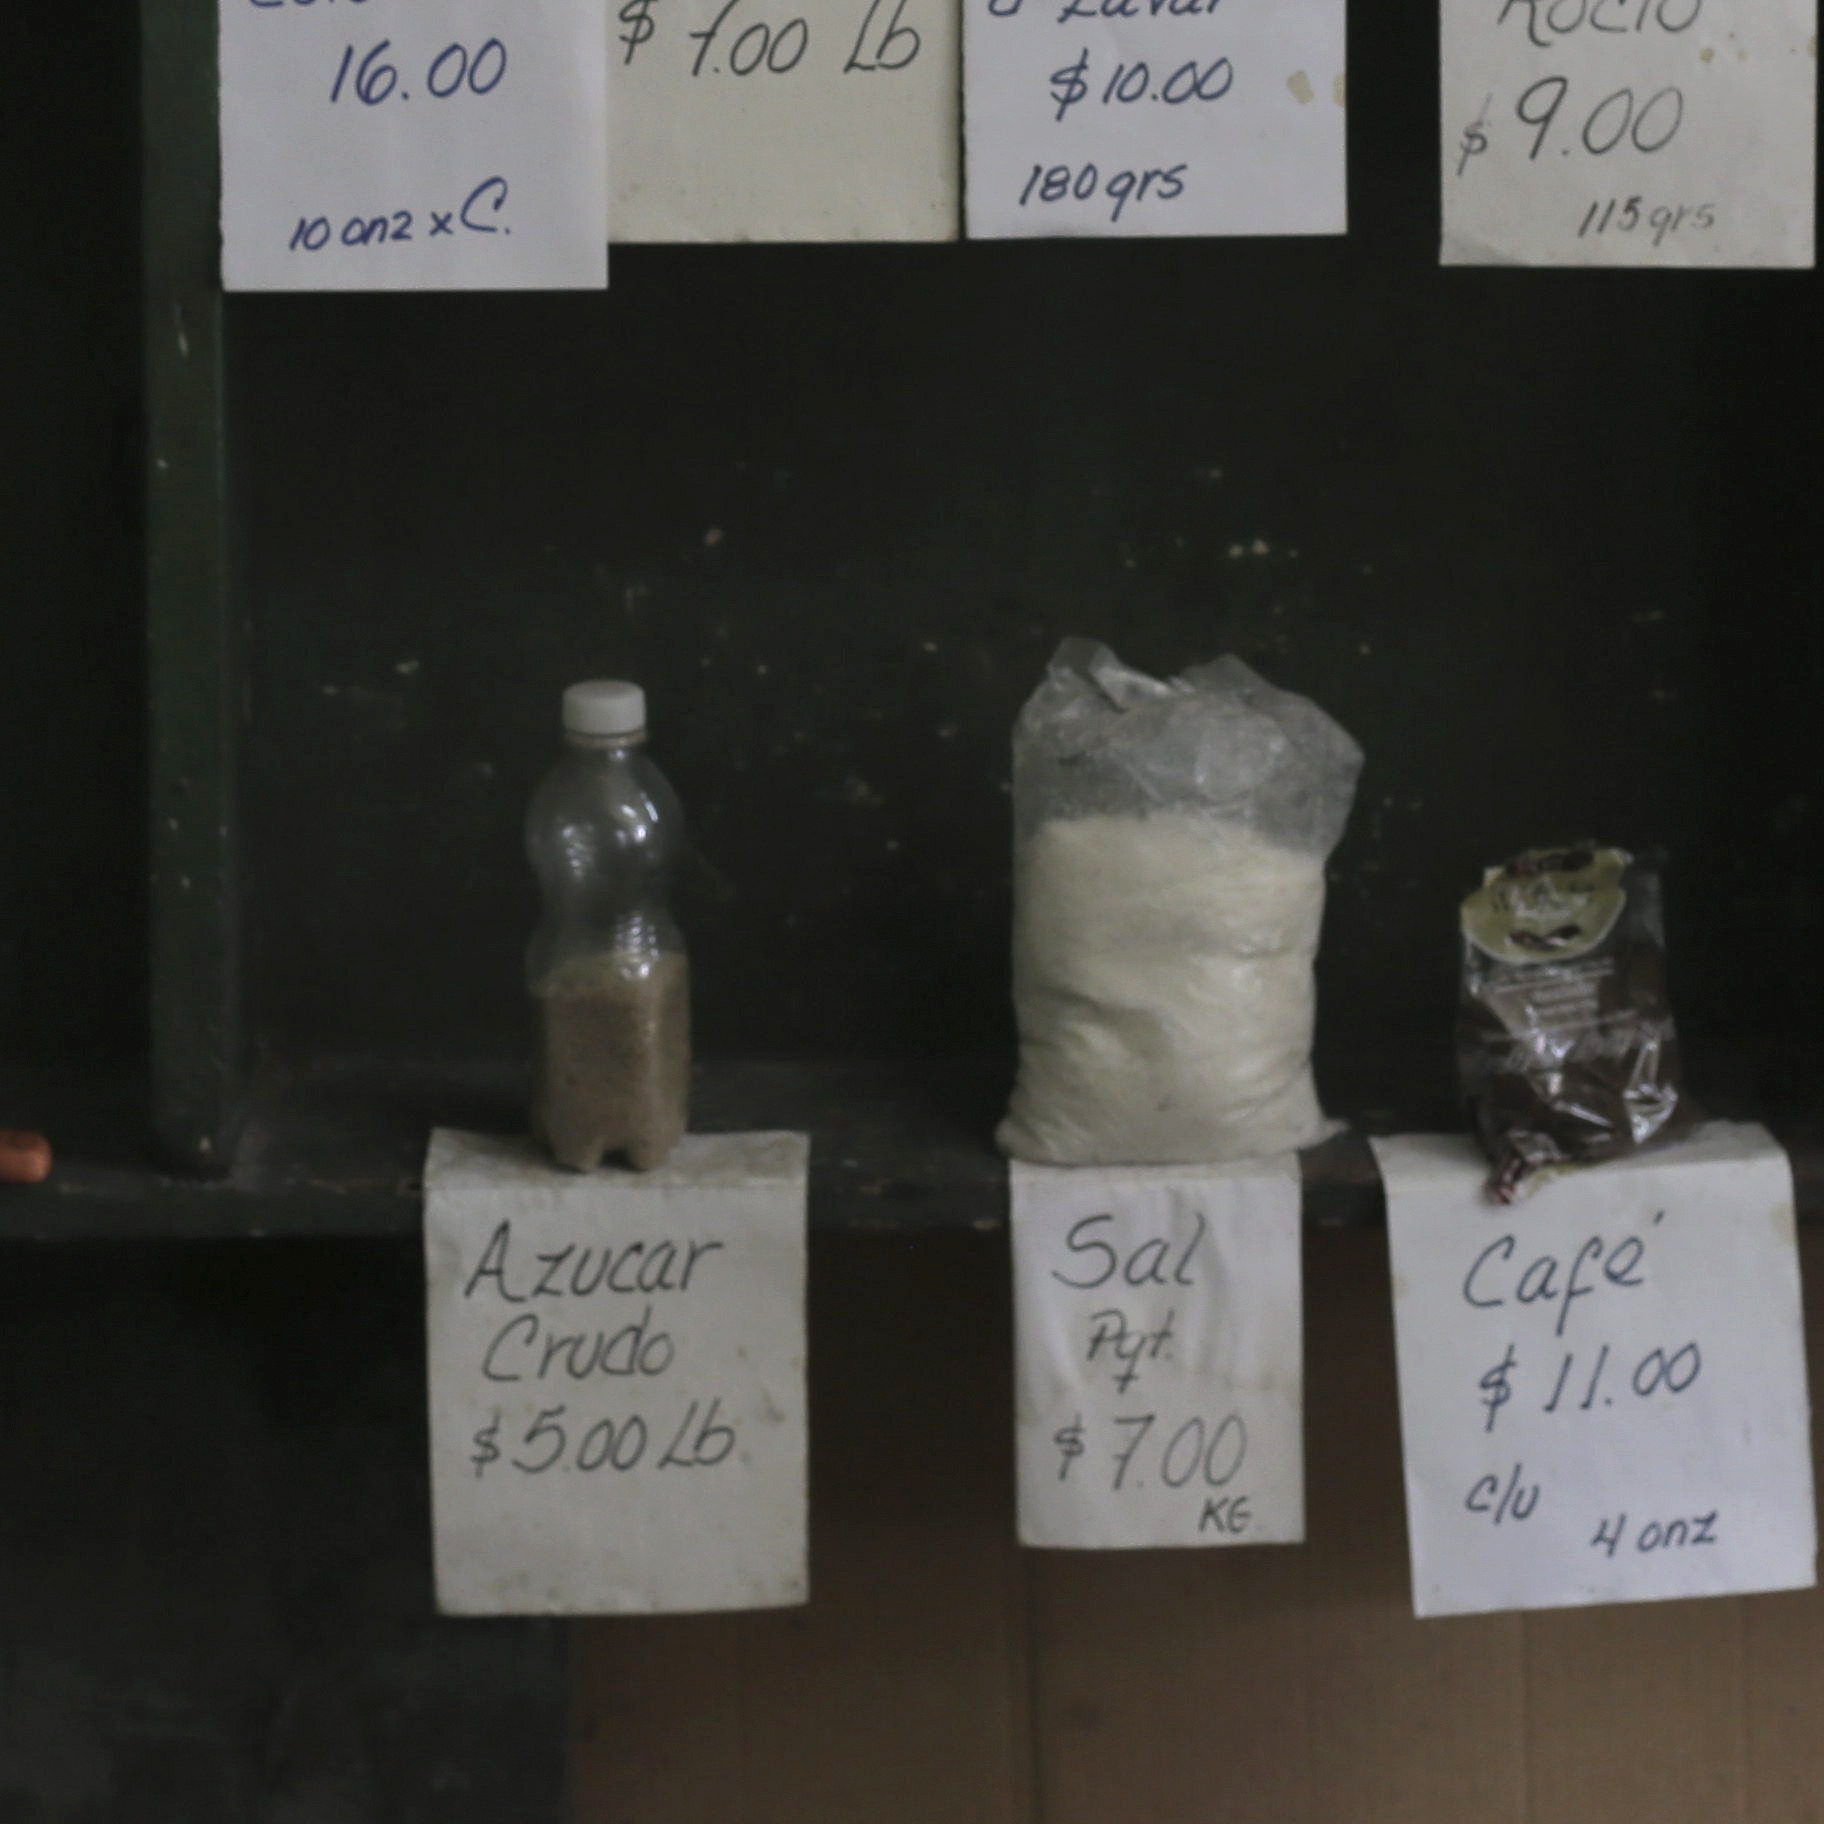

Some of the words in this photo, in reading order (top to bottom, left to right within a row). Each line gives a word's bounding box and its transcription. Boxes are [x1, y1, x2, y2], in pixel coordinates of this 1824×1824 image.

[330, 38, 508, 106] 16.00
[464, 1219, 725, 1304] Azucar
[1052, 1212, 1207, 1289] Sal
[1463, 1210, 1666, 1337] Café
[482, 1304, 675, 1383] Crudo
[1198, 1494, 1253, 1535] KG
[1592, 1513, 1628, 1558] 4
